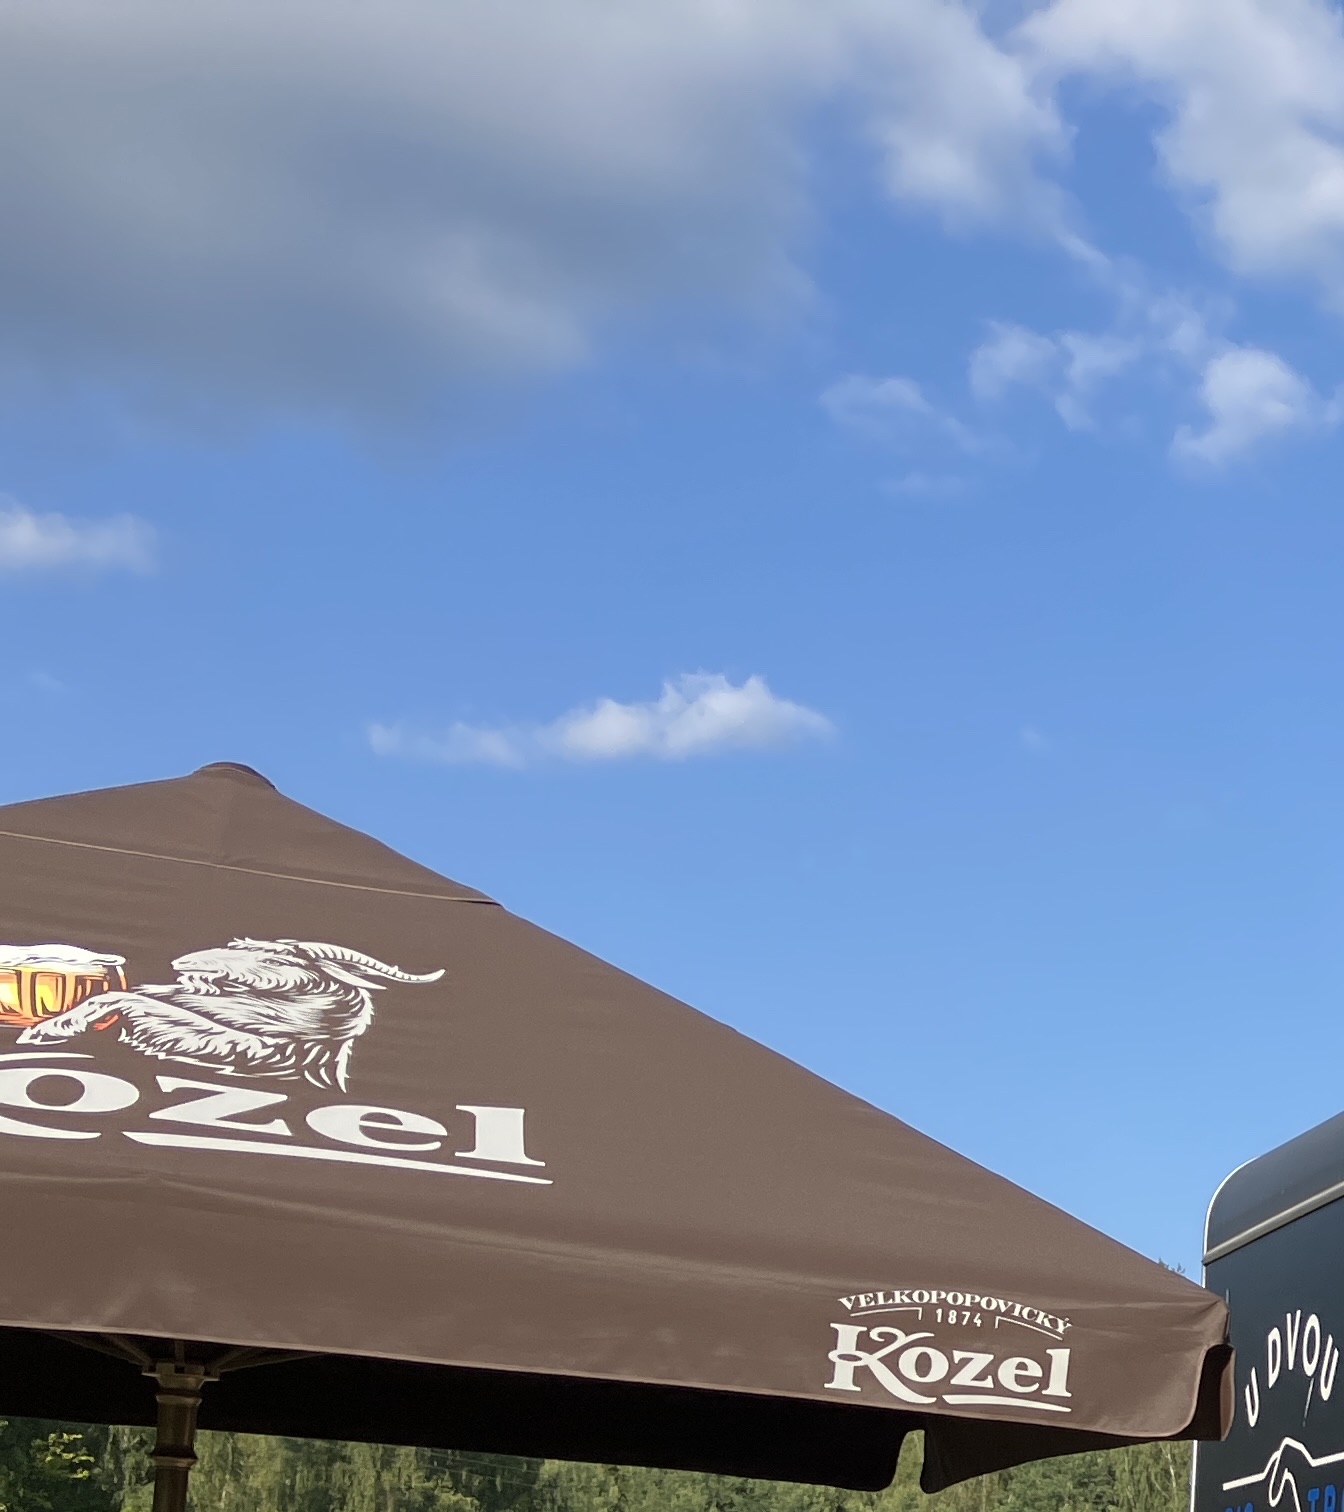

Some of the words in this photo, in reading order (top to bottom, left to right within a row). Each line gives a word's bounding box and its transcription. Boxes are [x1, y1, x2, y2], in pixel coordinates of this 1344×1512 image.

[0, 1055, 547, 1170] ozel
[838, 1290, 1073, 1334] VELKOPOPOVICKÝ
[936, 1308, 983, 1327] 1874
[824, 1323, 1073, 1406] Kozel
[1245, 1366, 1259, 1428] U
[1267, 1310, 1339, 1401] DVOU
